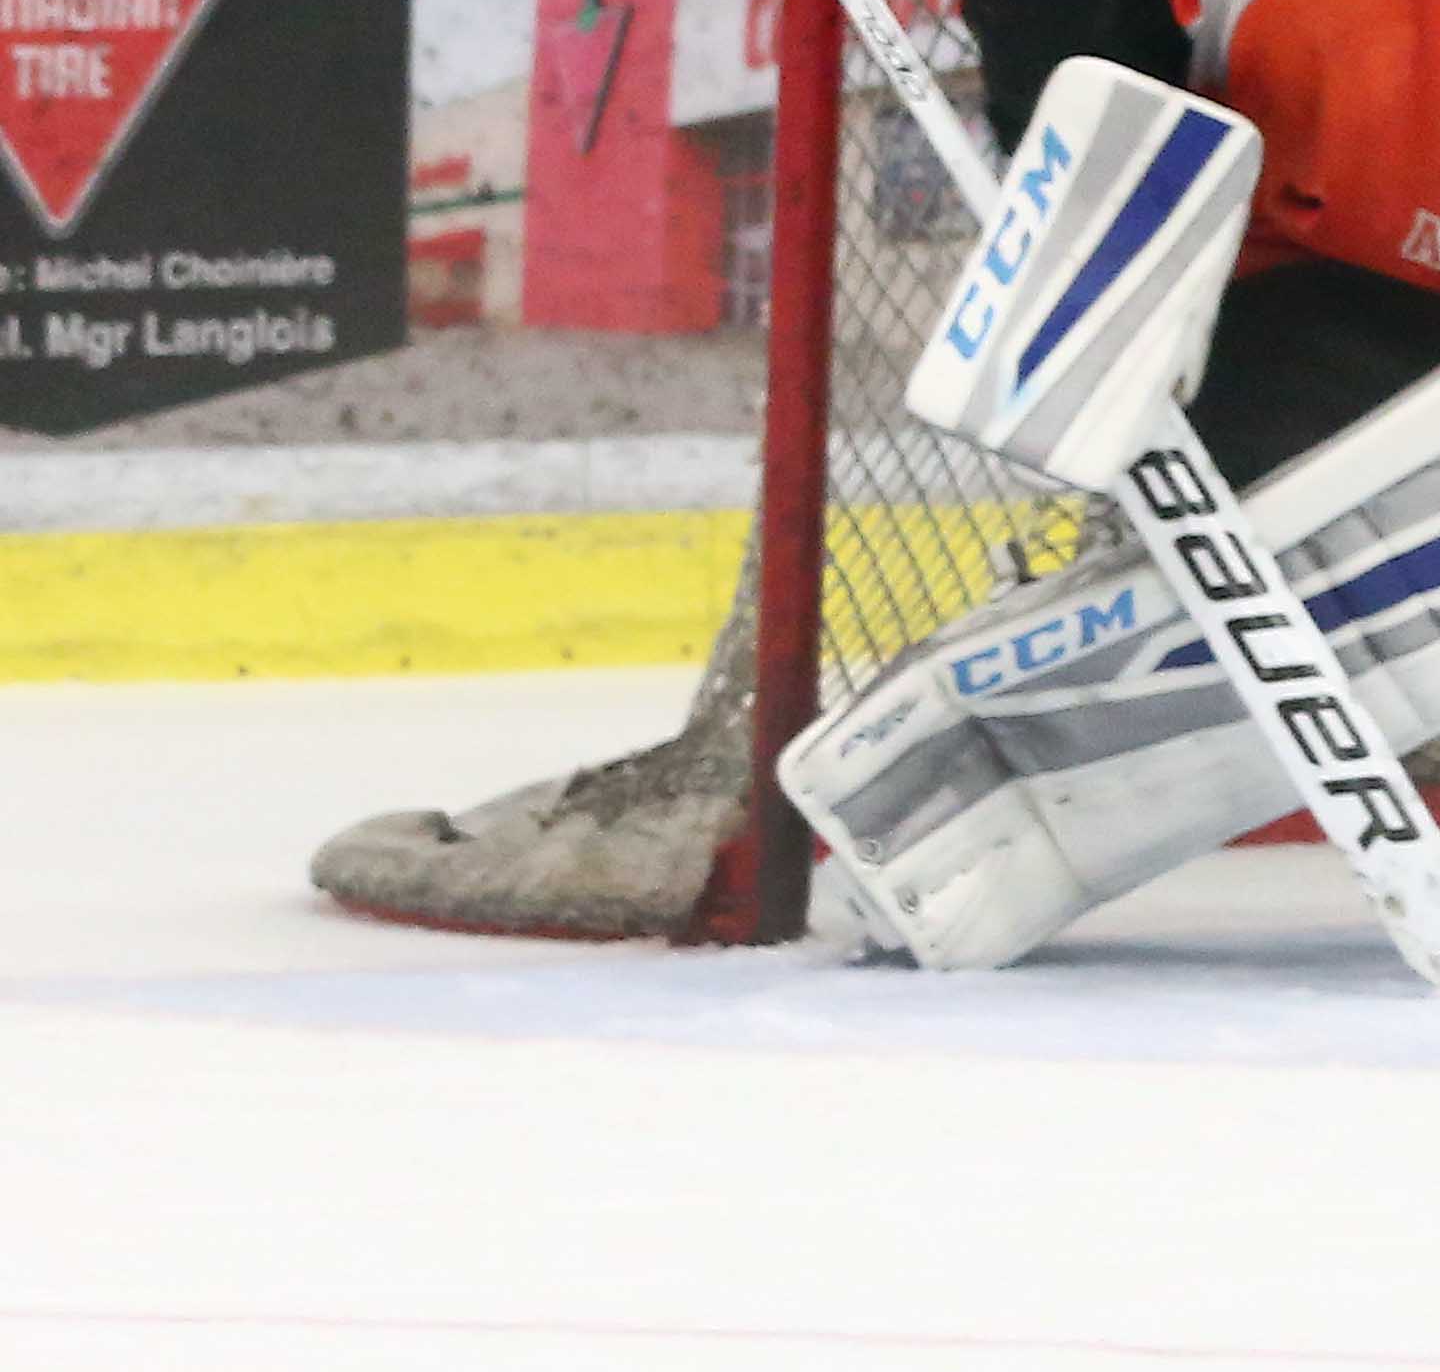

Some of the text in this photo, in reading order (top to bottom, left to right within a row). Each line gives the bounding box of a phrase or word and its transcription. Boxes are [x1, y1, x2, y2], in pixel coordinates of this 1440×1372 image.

[12, 43, 113, 99] TIRE
[945, 122, 1072, 361] CCM
[46, 309, 132, 369] Mgr
[142, 307, 335, 364] Langlois
[950, 588, 1136, 696] CCM
